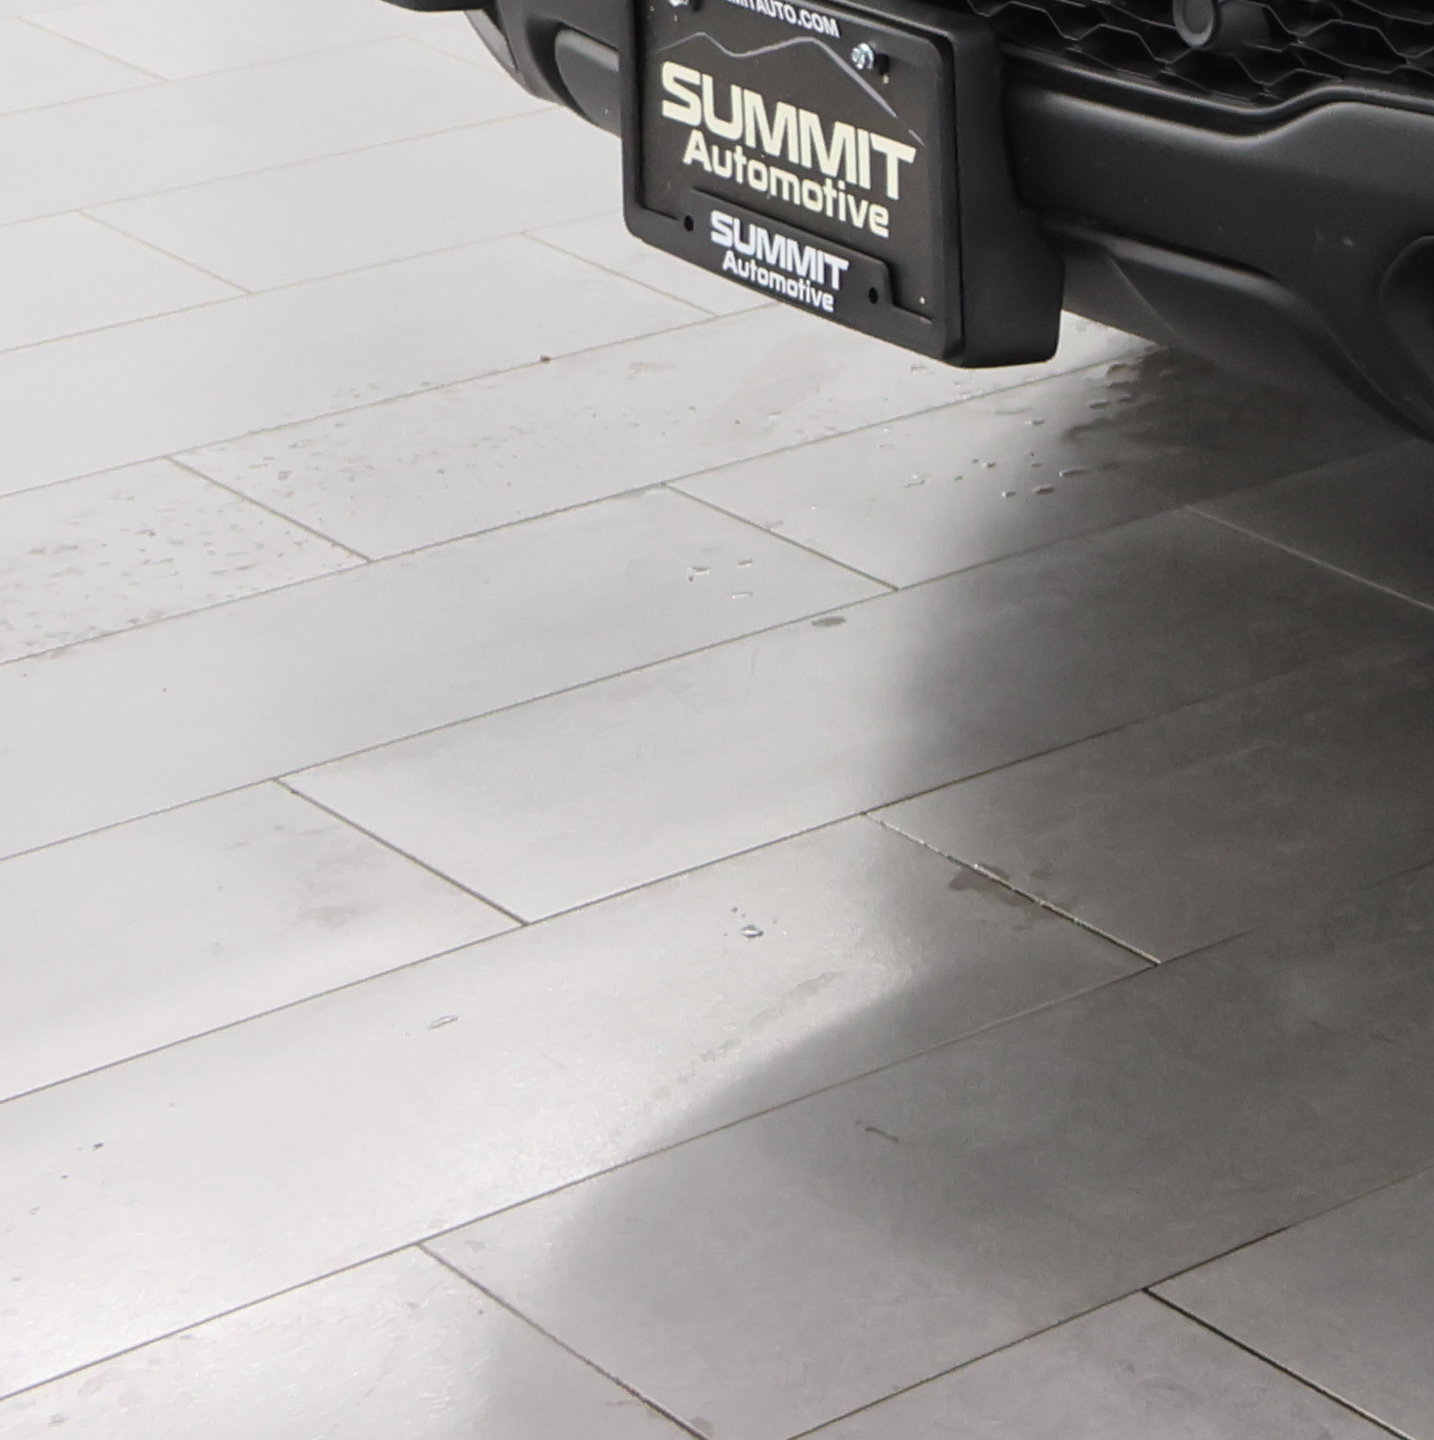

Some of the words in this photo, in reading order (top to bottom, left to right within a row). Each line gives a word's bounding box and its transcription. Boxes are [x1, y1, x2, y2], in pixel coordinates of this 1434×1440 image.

[660, 61, 917, 201] SUMMIT
[682, 129, 890, 238] Automotive
[709, 210, 850, 291] SUMMIT
[721, 249, 835, 313] Automotive
